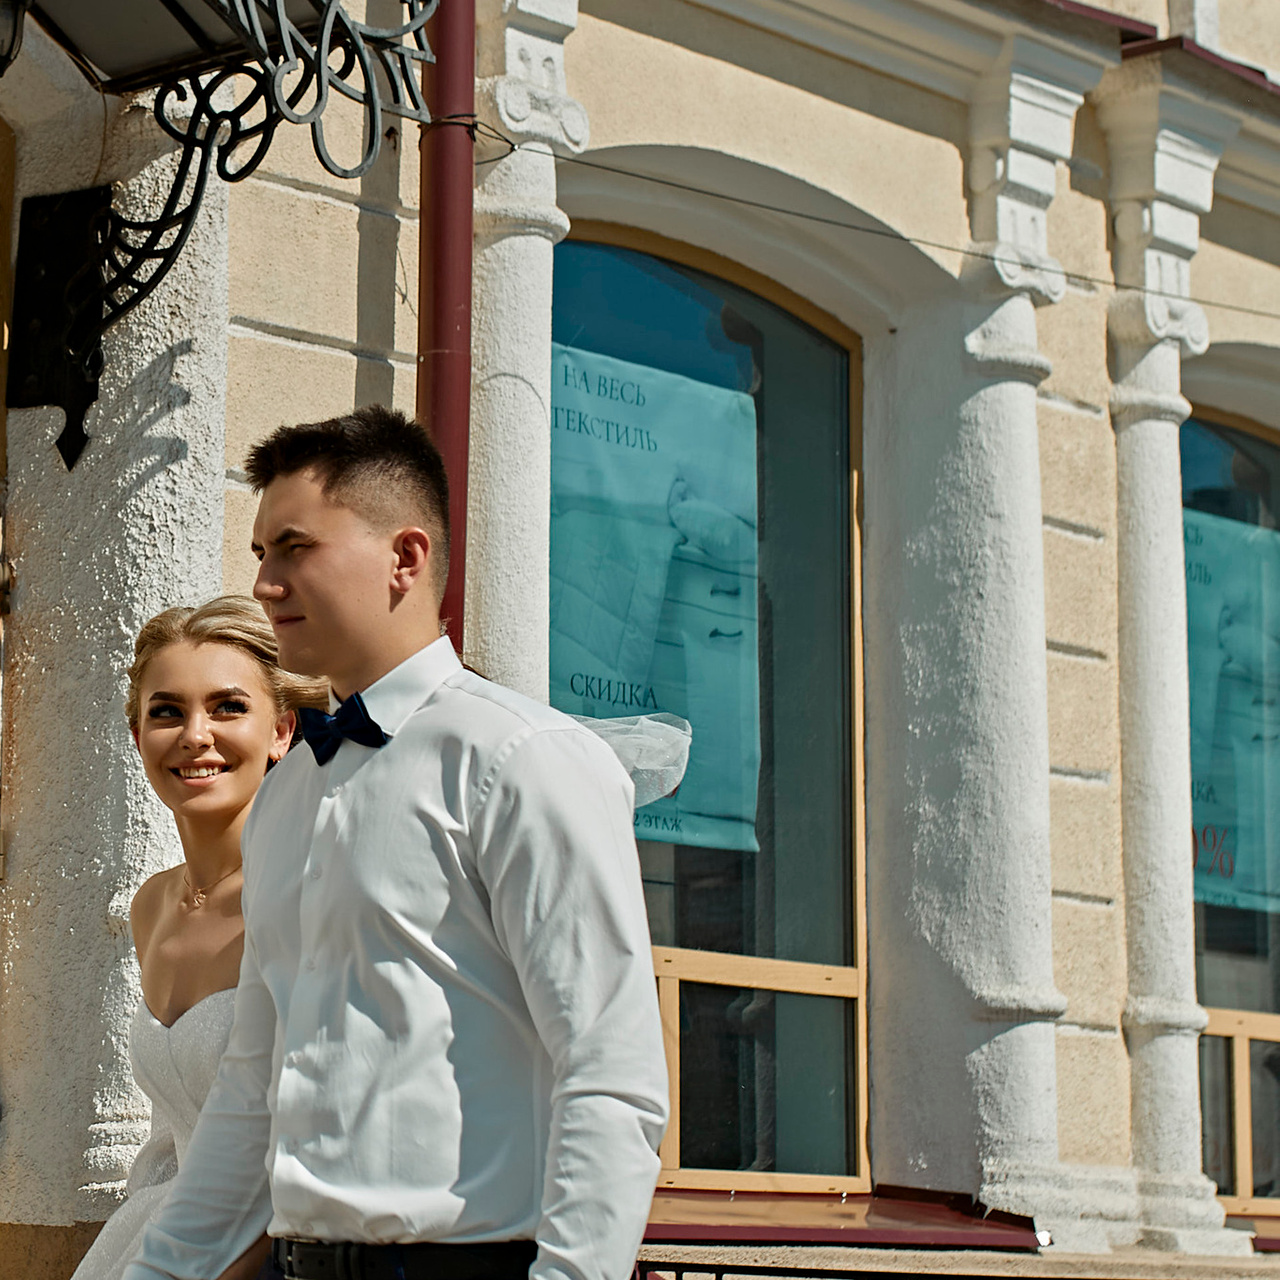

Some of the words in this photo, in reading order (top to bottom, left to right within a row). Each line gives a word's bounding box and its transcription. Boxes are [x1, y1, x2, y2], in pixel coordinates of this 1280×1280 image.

[563, 364, 590, 394] НА
[597, 375, 646, 407] ВЕСЬ
[551, 406, 658, 452] ТЕКСТИЛЬ
[570, 672, 658, 709] СКИДКА
[643, 813, 682, 833] ЭТАЖ
